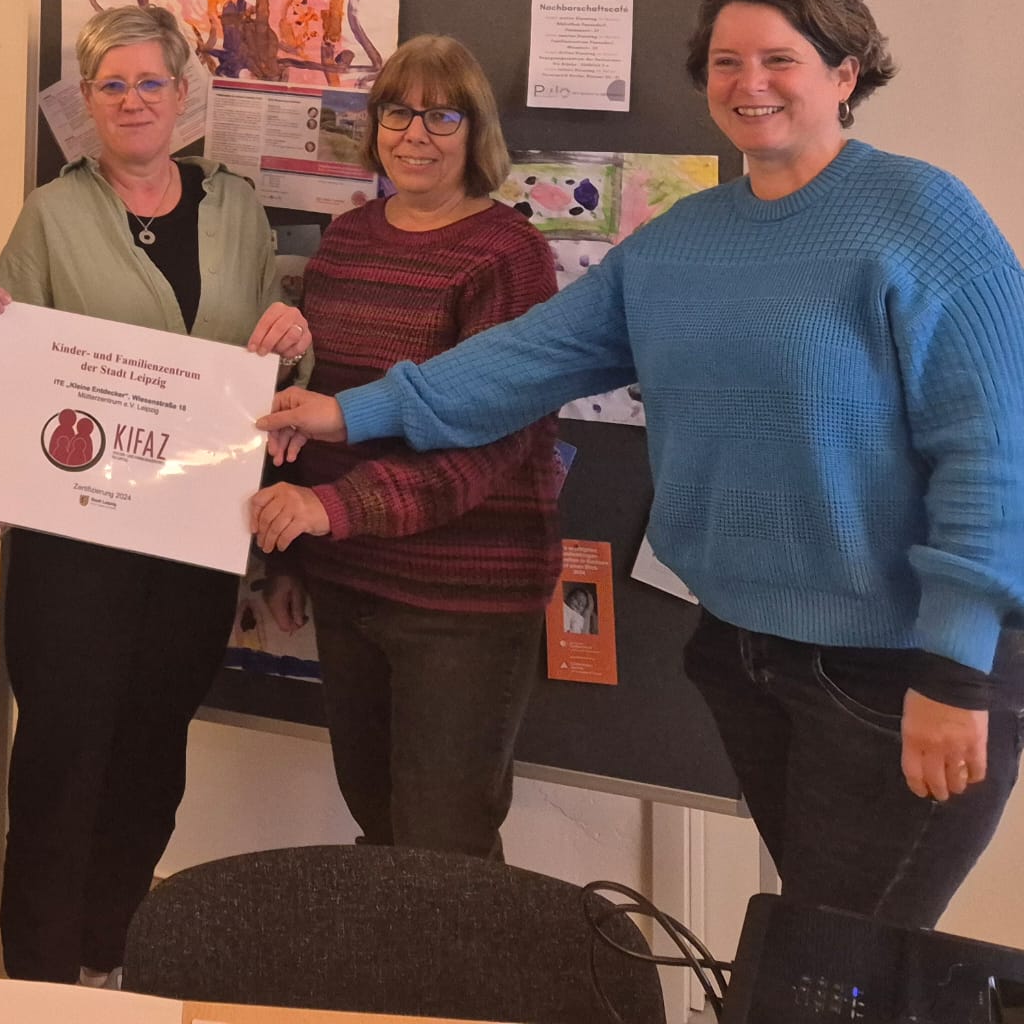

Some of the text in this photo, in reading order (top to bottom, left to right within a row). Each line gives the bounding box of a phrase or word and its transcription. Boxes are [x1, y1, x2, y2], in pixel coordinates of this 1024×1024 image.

[51, 341, 201, 381] Kinder- und Familienzentrum
[81, 362, 167, 389] der Stadt Leipzig
[77, 391, 123, 406] Mütterzentrum
[137, 403, 160, 416] Leipzig
[132, 394, 178, 410] Wiesenstraße
[114, 423, 170, 461] KIFAZ
[115, 492, 132, 501] 2024
